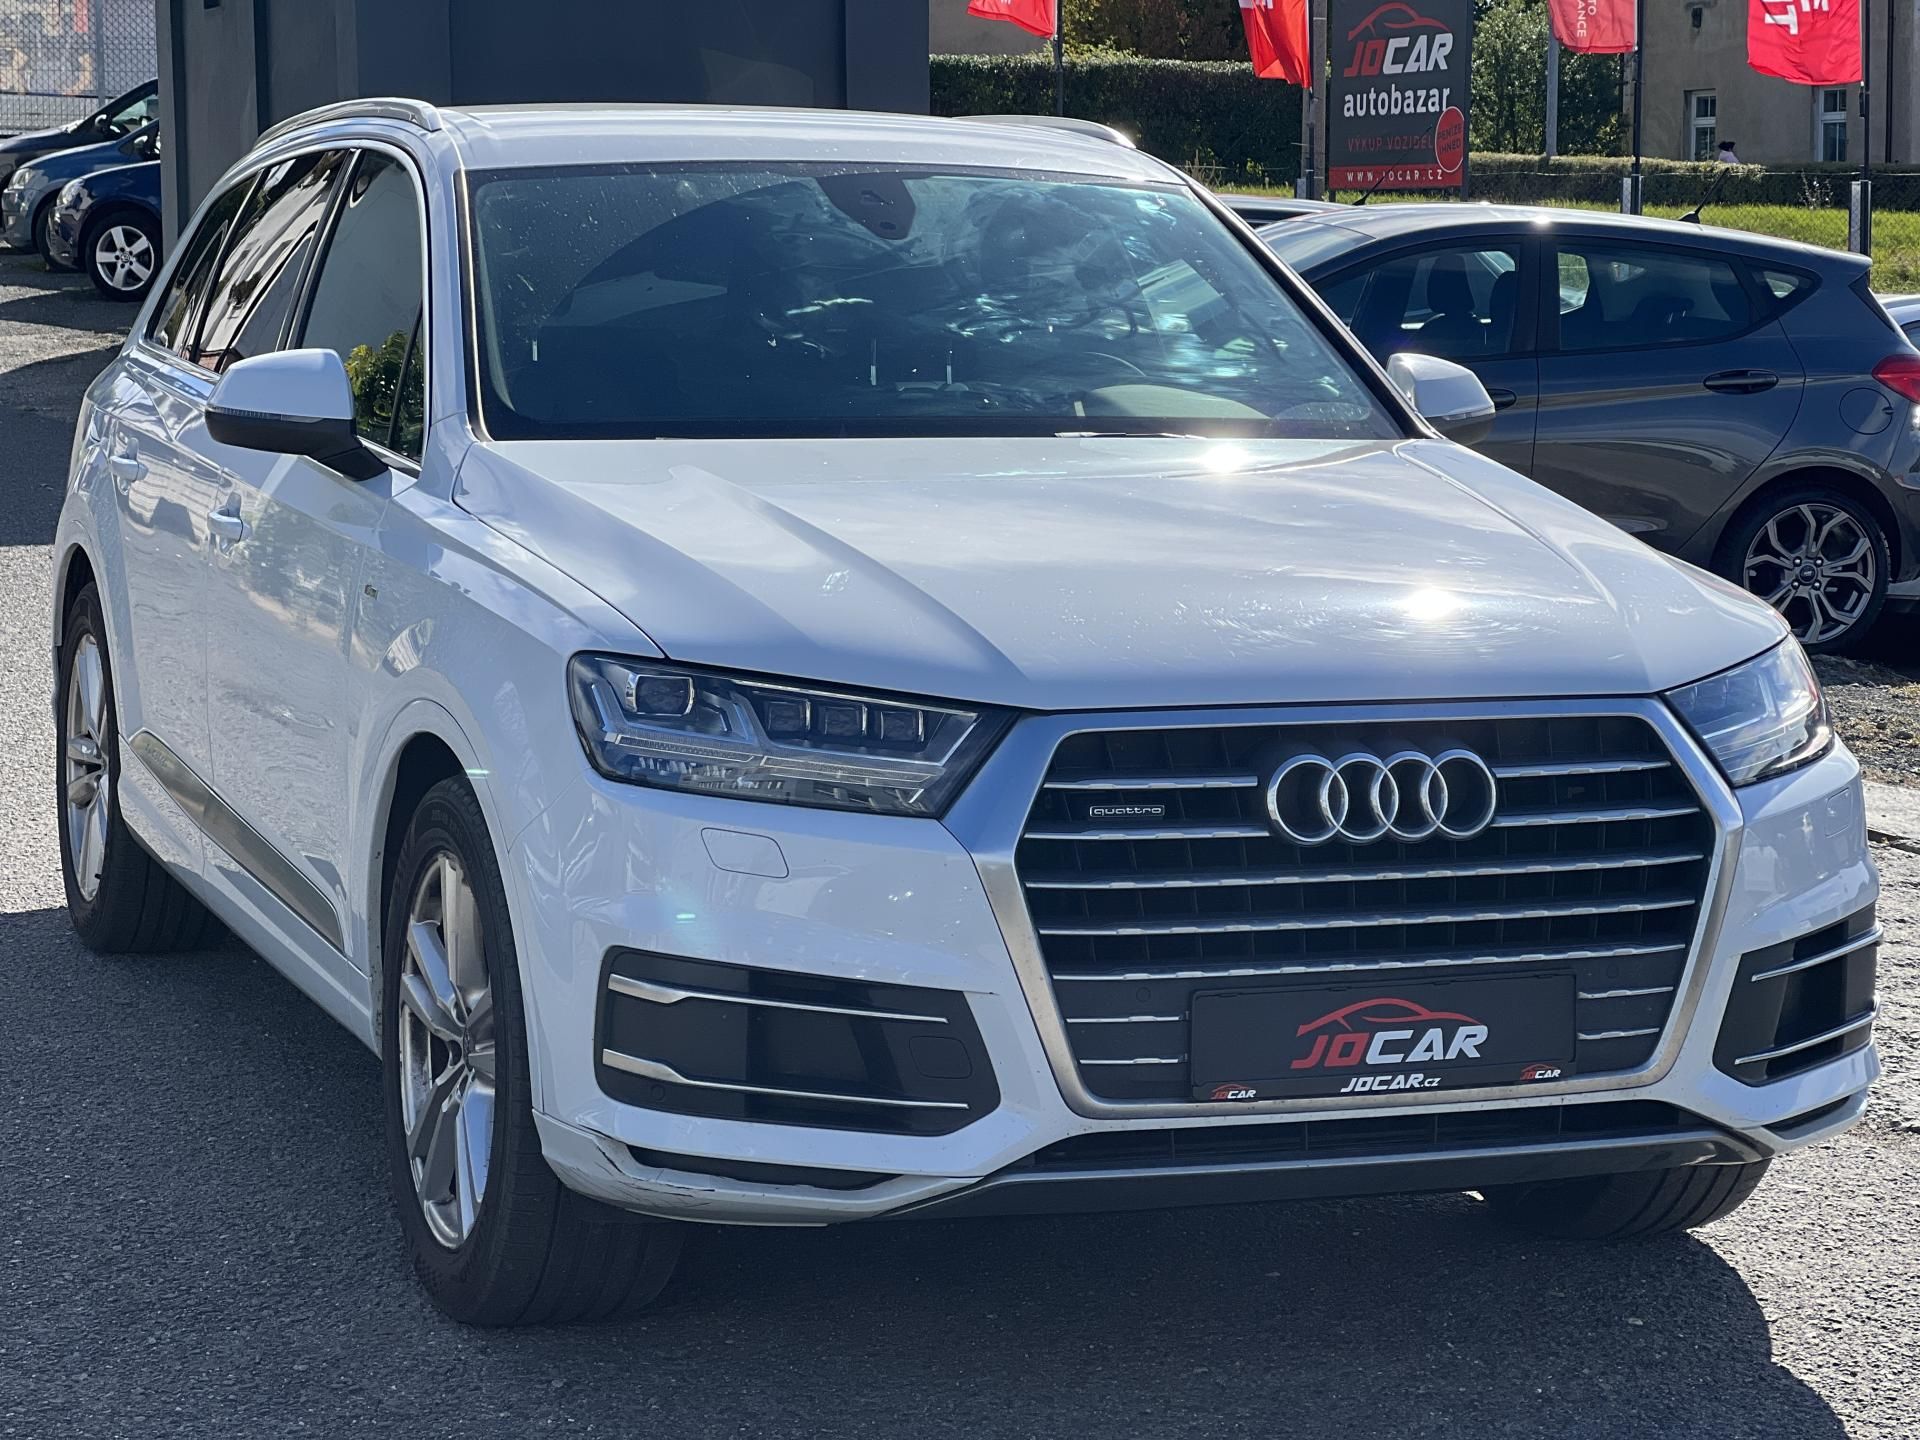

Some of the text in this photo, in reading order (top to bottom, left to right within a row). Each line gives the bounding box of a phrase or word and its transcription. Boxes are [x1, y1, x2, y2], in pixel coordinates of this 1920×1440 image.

[1344, 33, 1454, 77] JOCAR
[1343, 83, 1450, 117] autobazar
[1347, 134, 1434, 152] VÝKUP VOZIDEL
[1093, 807, 1162, 816] quattro
[1290, 1025, 1489, 1069] JOCAR
[1520, 1069, 1561, 1080] JOCAR
[1210, 1089, 1257, 1100] JOCAR
